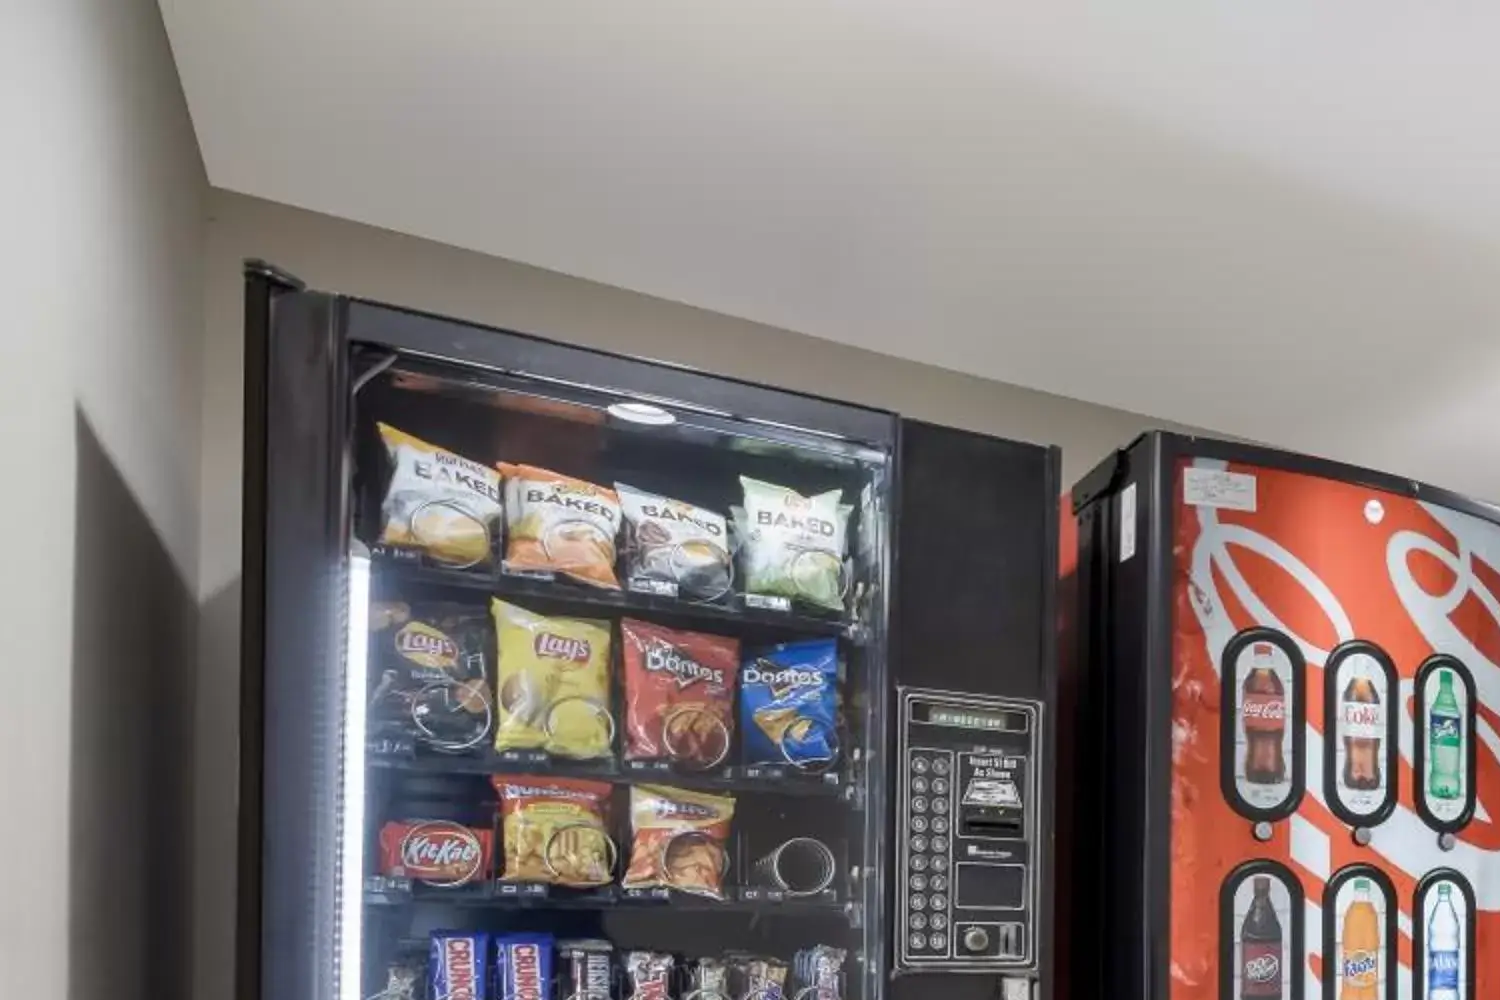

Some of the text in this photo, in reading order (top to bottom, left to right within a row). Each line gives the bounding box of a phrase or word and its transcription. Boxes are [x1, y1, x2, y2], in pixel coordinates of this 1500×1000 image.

[526, 488, 614, 522] BAKED
[756, 509, 836, 538] BAKED
[538, 632, 590, 662] Lay's
[742, 666, 825, 687] Doritos
